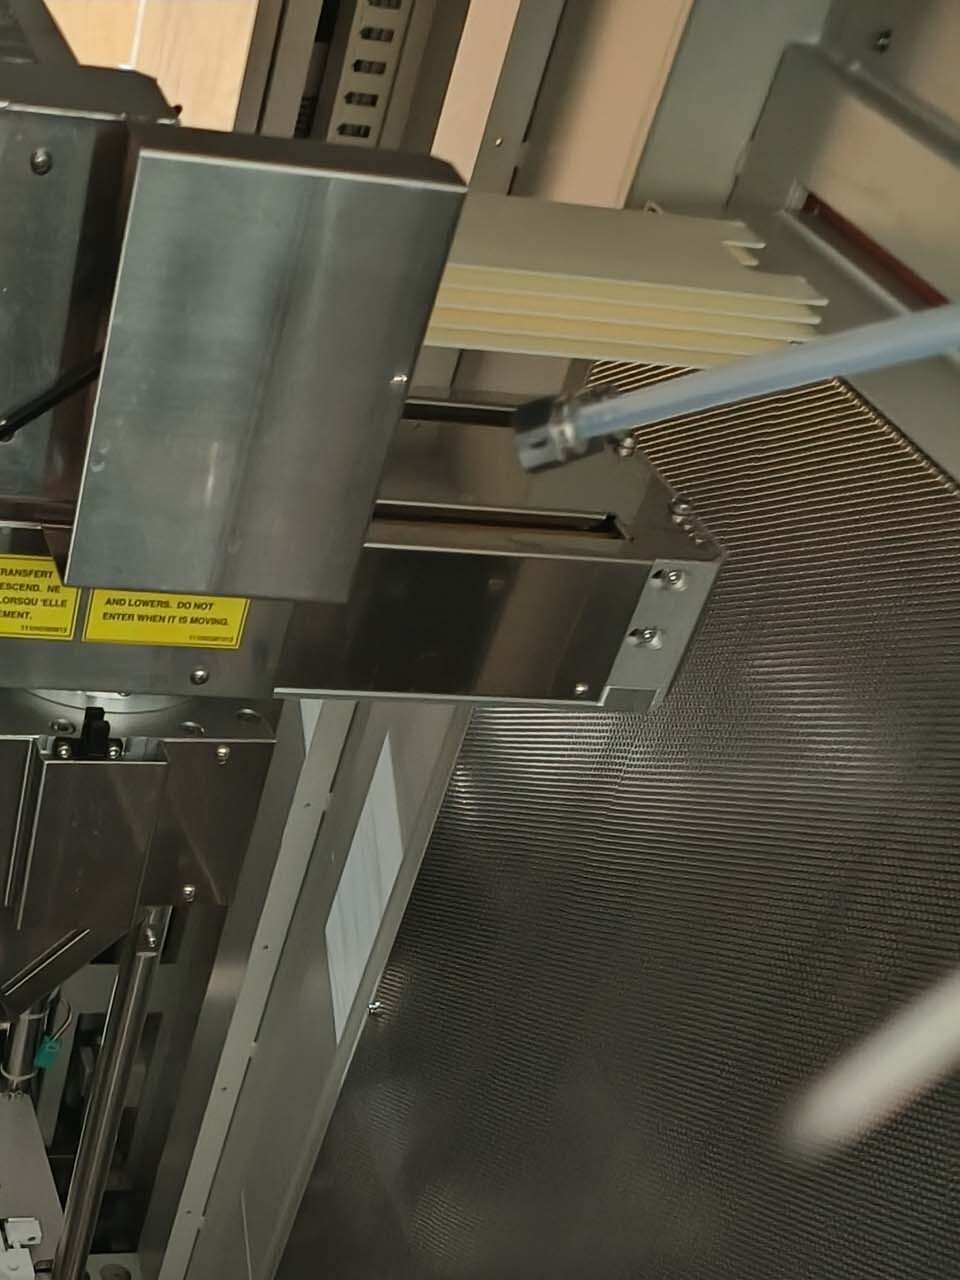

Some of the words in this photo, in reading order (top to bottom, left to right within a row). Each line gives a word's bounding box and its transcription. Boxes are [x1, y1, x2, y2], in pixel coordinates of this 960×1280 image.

[46, 584, 61, 593] NE
[104, 597, 126, 607] AND
[176, 600, 192, 610] DO
[193, 601, 215, 611] NOT
[102, 611, 136, 622] ENTER
[137, 613, 166, 624] WHEN
[166, 615, 177, 625] IT
[178, 616, 188, 625] IS
